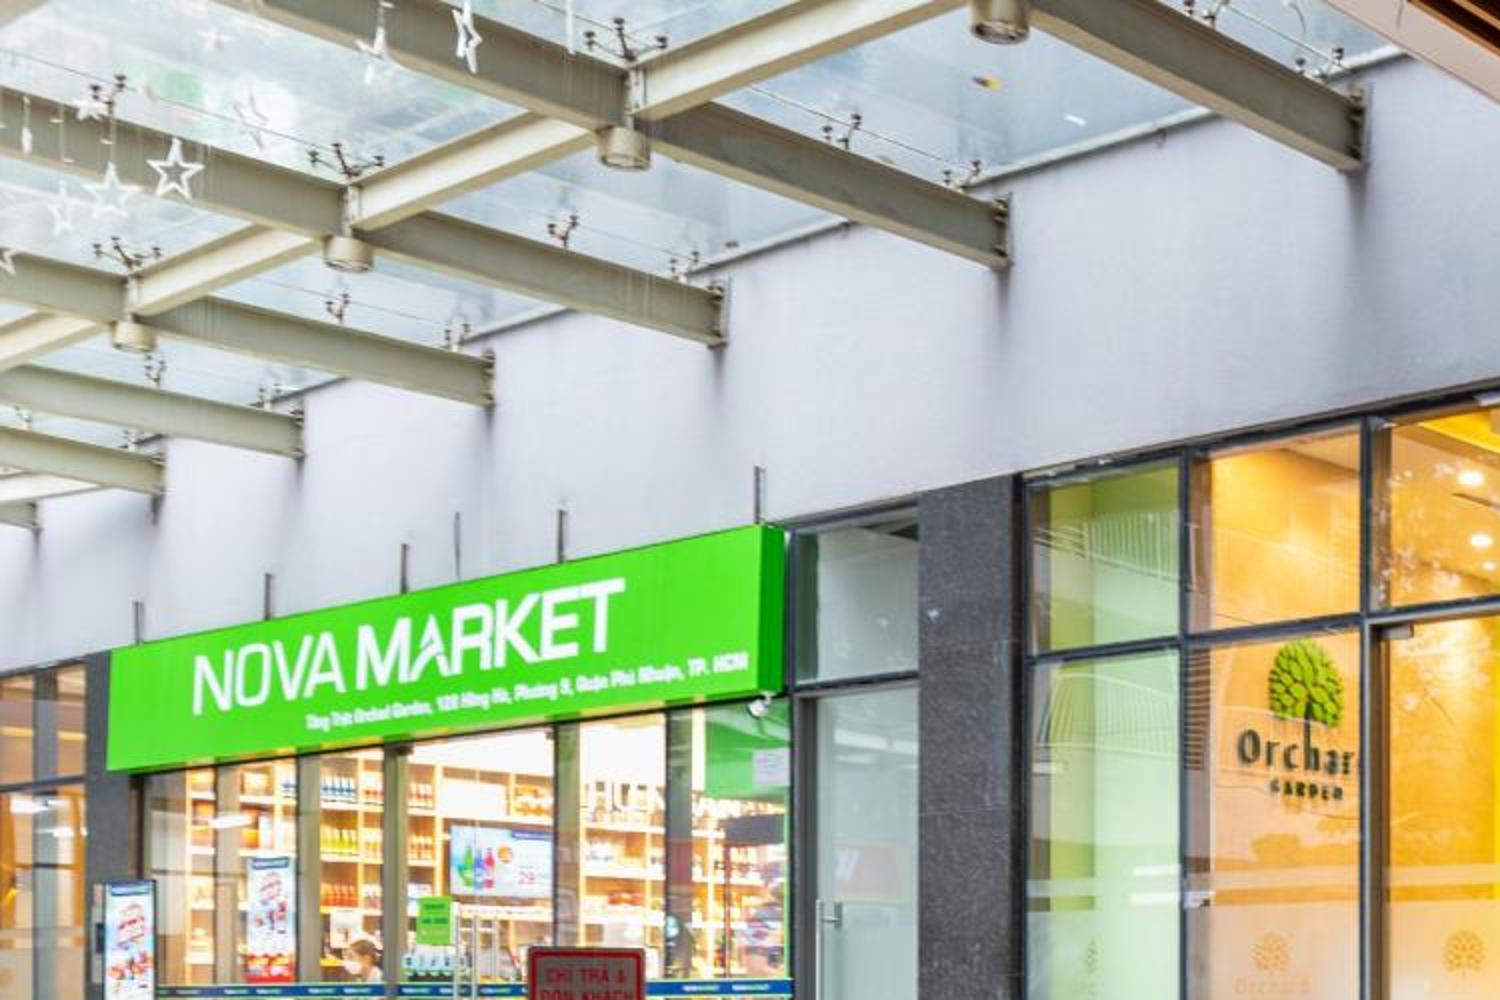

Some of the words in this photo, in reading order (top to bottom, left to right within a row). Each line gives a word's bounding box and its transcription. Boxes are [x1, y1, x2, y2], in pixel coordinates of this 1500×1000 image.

[193, 631, 347, 717] NOVA
[355, 577, 626, 690] MARKET
[1237, 728, 1355, 775] Orchar
